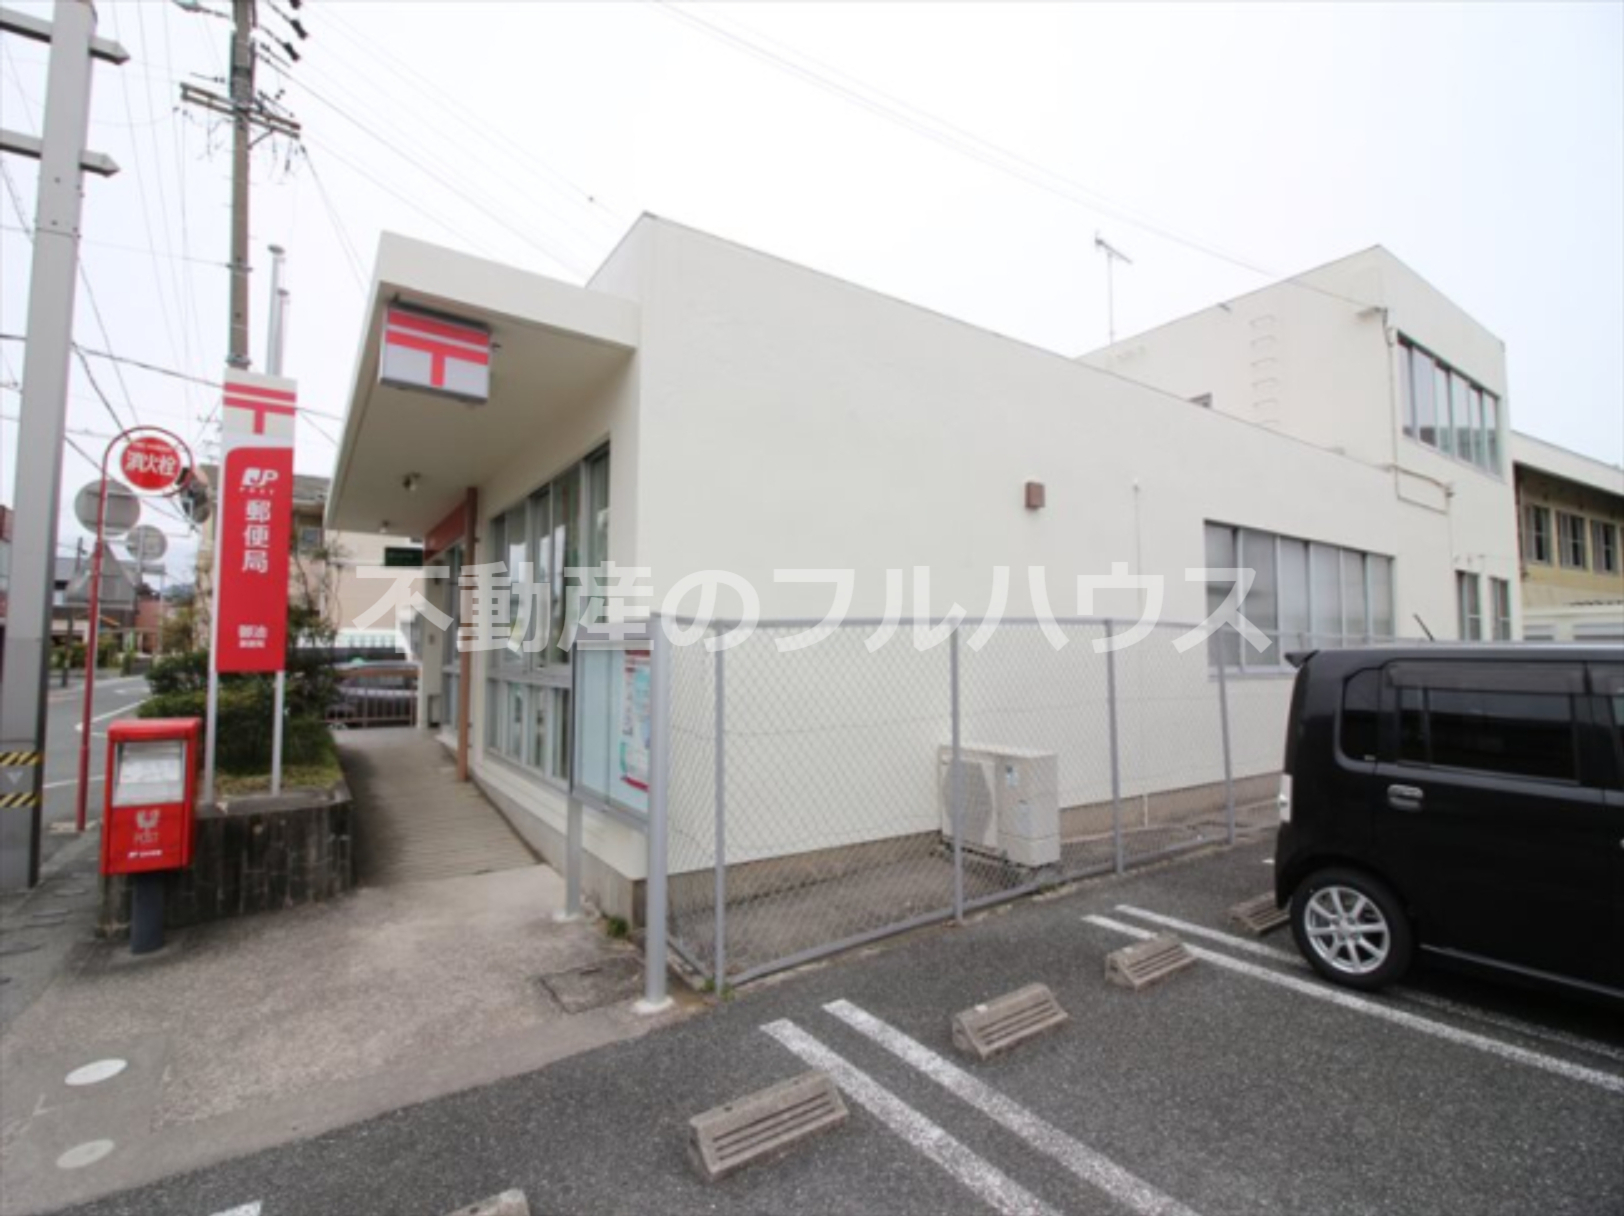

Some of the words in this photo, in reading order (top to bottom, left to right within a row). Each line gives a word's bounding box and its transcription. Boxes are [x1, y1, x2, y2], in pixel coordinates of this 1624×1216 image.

[125, 450, 177, 477] 消火栓
[241, 499, 272, 574] 郵便局
